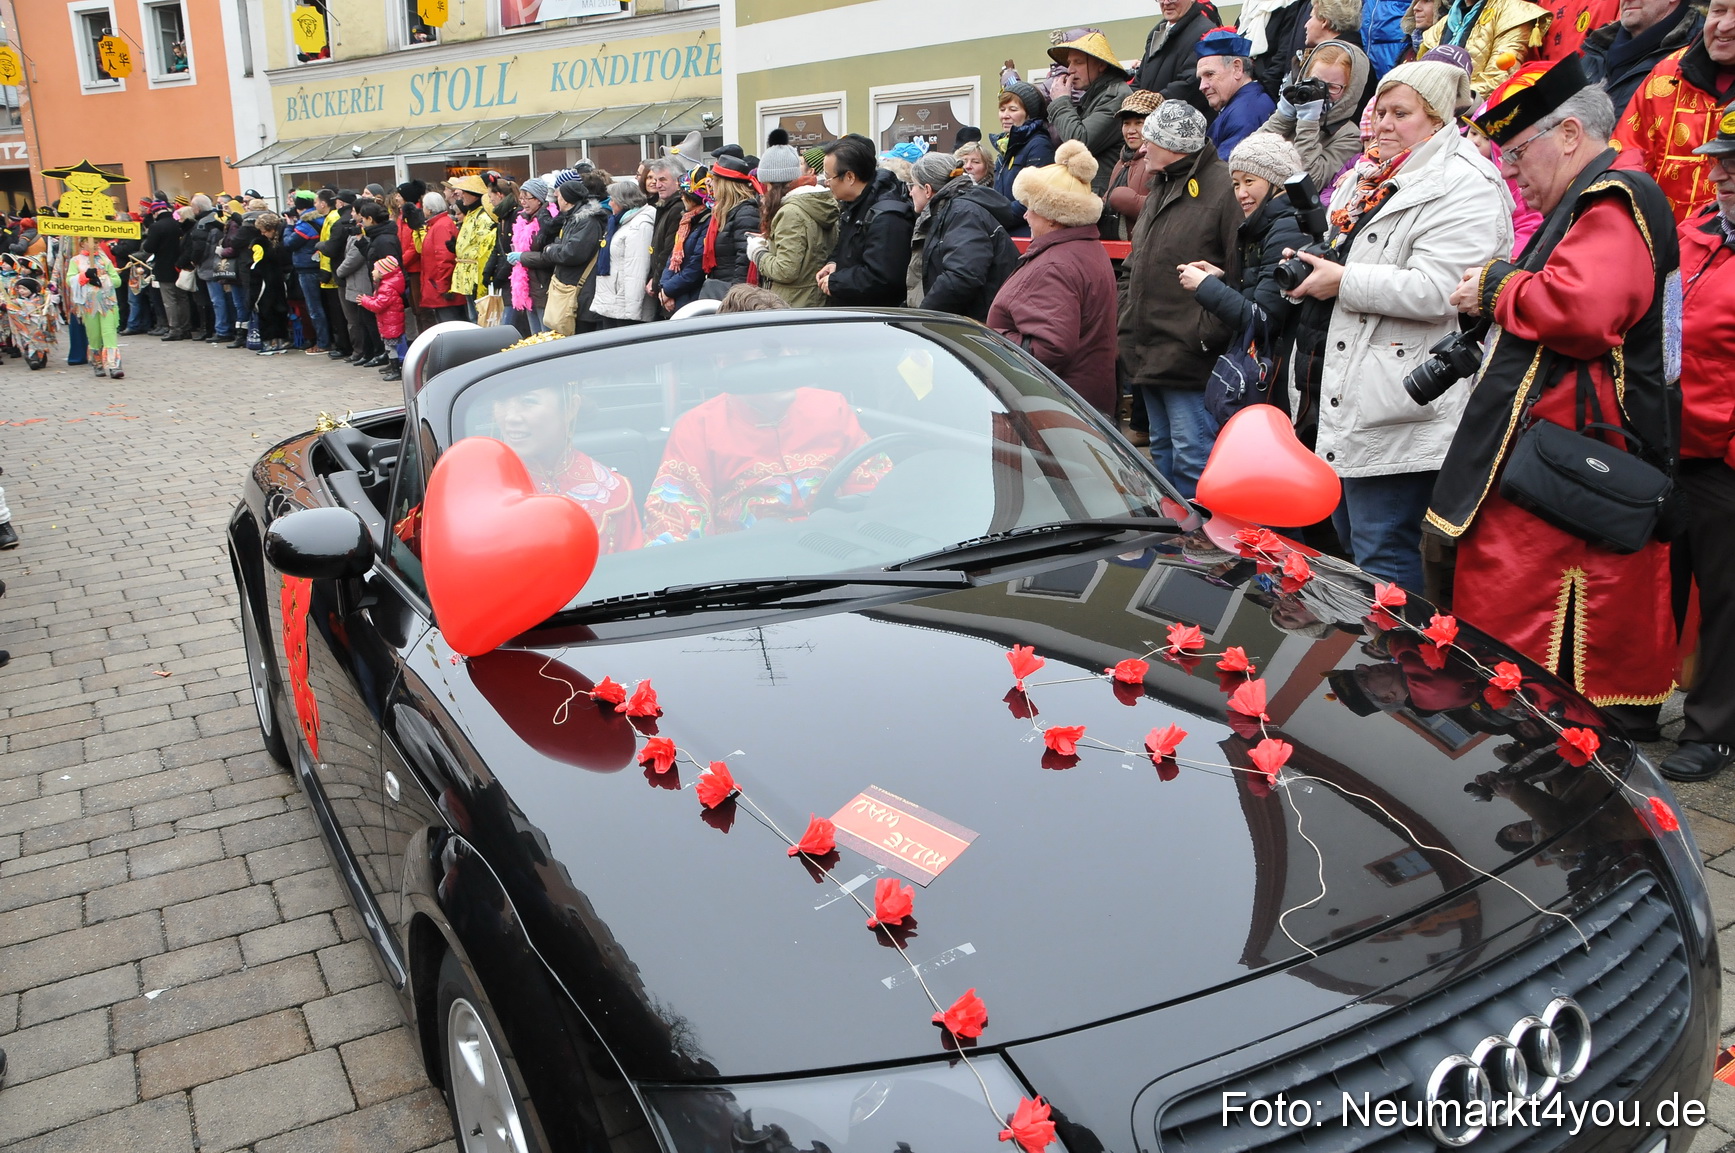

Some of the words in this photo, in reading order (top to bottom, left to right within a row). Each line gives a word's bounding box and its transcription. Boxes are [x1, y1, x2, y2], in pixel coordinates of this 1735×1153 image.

[286, 84, 385, 122] BÄCKEREI
[409, 62, 518, 117] STOLL
[550, 42, 722, 92] KONDITORE
[788, 132, 822, 142] ÖHLICH
[43, 222, 101, 233] Kindergarten
[103, 225, 134, 235] Dietfurt
[883, 831, 948, 870] KILLE
